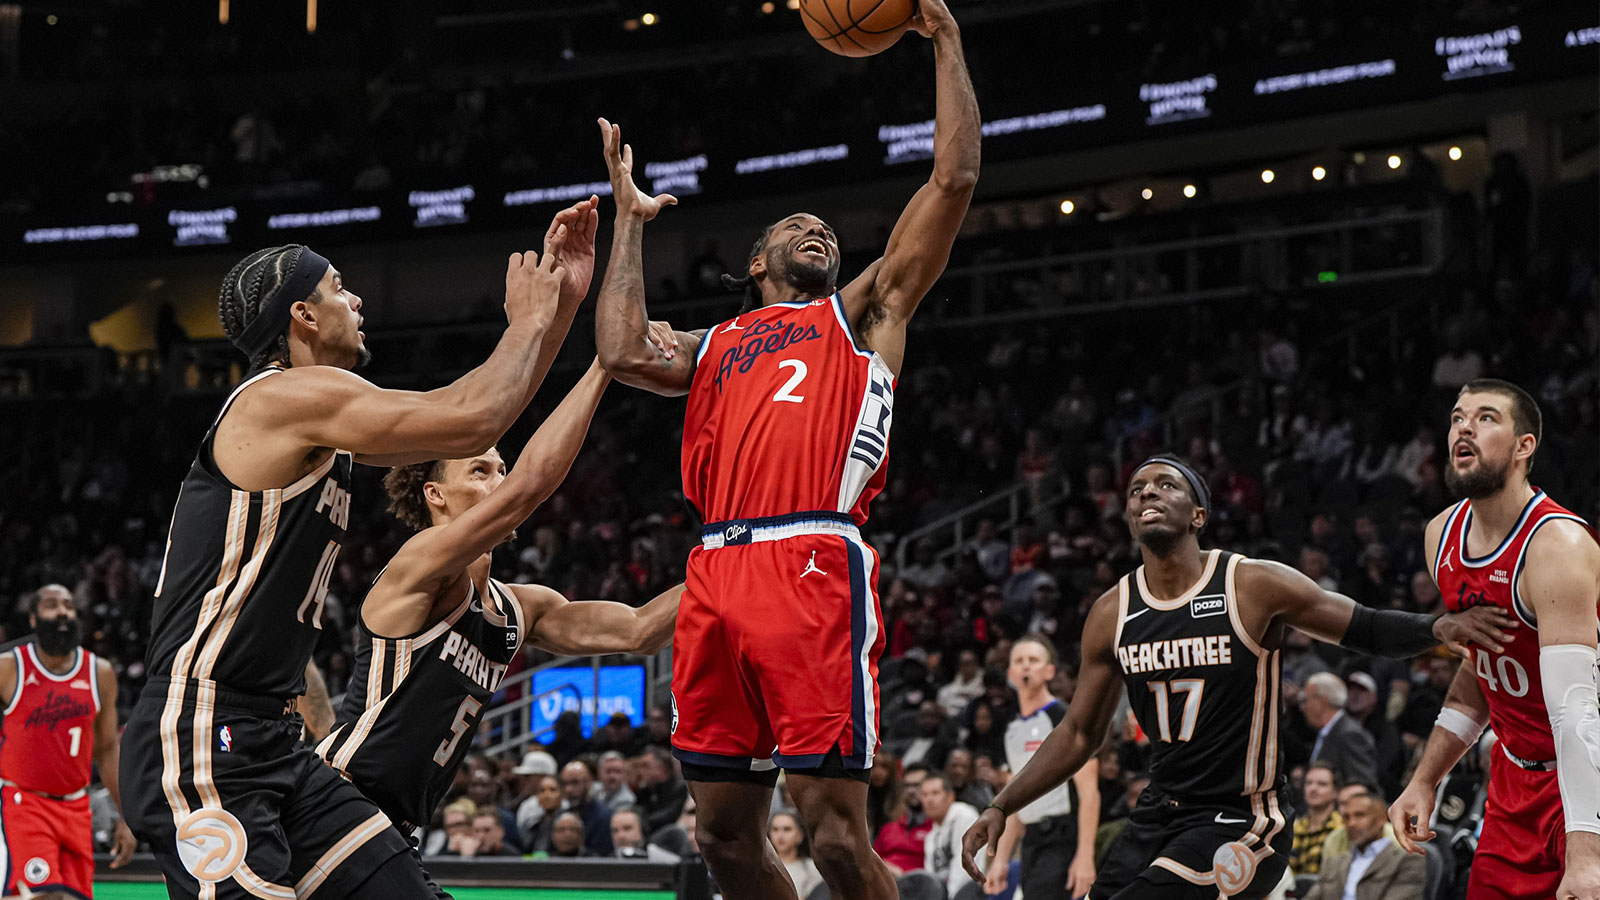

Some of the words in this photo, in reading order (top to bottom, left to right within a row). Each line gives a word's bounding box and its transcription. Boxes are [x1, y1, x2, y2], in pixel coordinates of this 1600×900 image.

[740, 318, 786, 343] Los
[772, 358, 808, 403] 2
[725, 524, 748, 541] Clips
[297, 540, 342, 630] 14
[1194, 599, 1223, 613] paze
[1118, 635, 1232, 675] PEACHTREE
[1476, 648, 1529, 698] 40
[433, 694, 483, 767] 5
[1146, 678, 1206, 744] 17
[68, 726, 82, 757] 1
